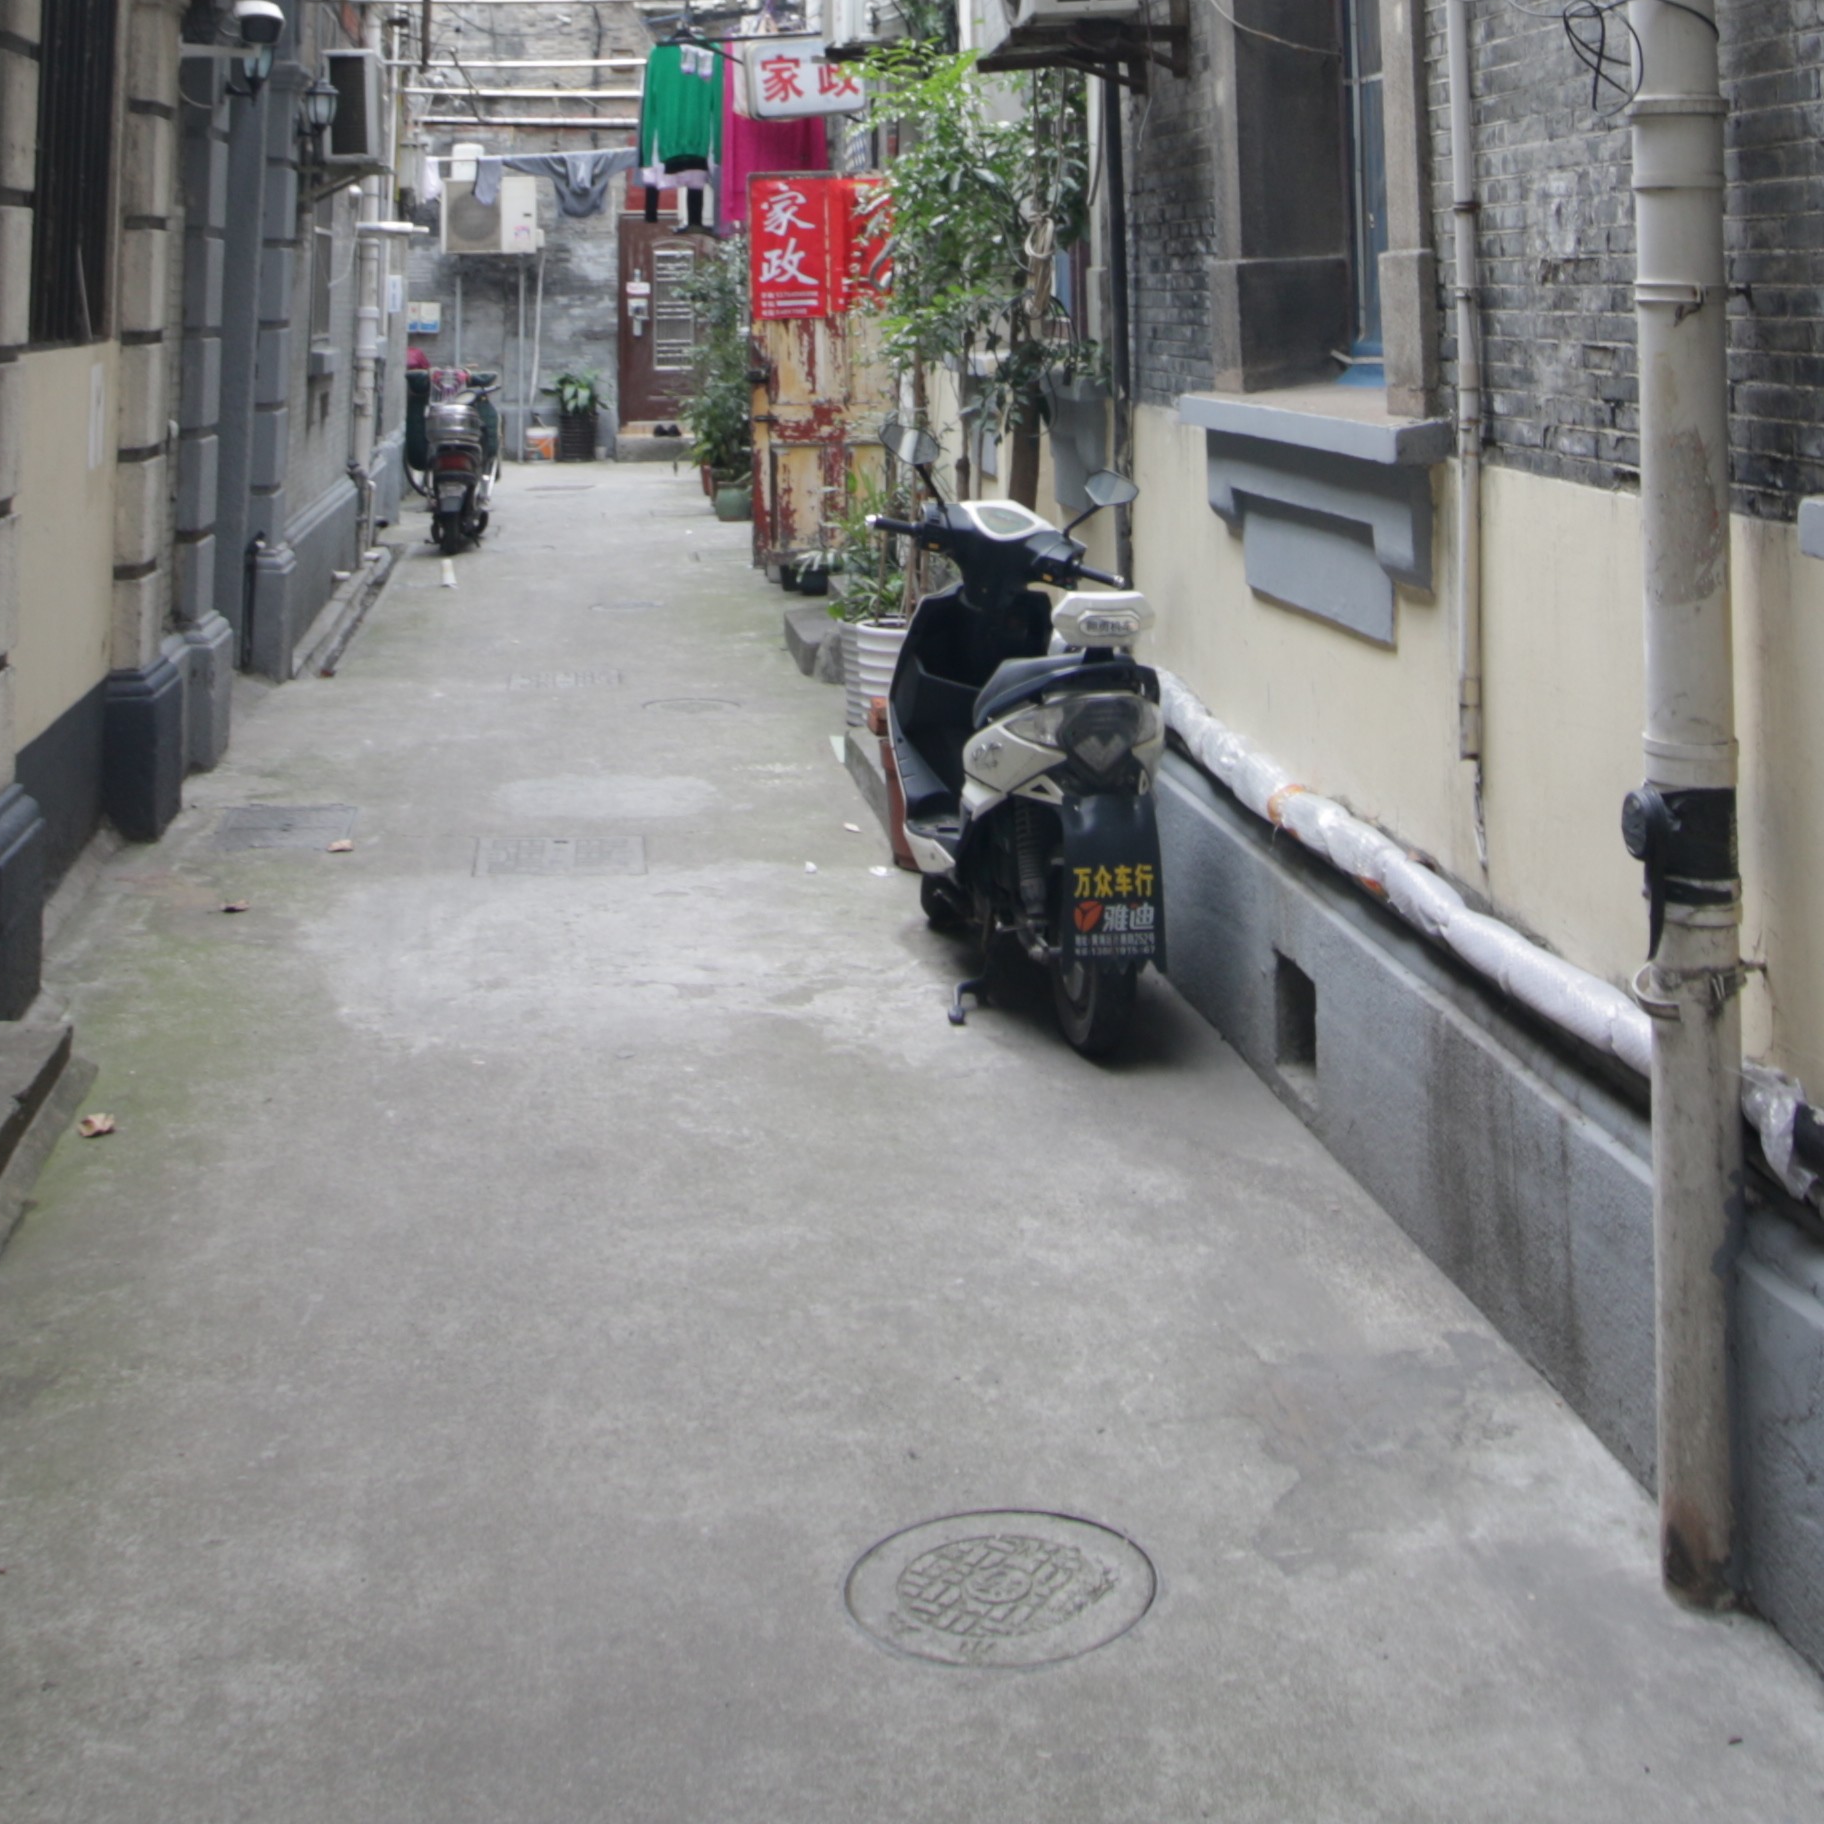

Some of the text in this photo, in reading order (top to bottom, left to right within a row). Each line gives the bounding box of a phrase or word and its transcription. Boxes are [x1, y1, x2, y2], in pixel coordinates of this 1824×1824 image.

[760, 54, 861, 102] 家政
[759, 182, 819, 285] 家政
[1073, 863, 1154, 898] 万众车行
[1102, 901, 1155, 932] 雅迪
